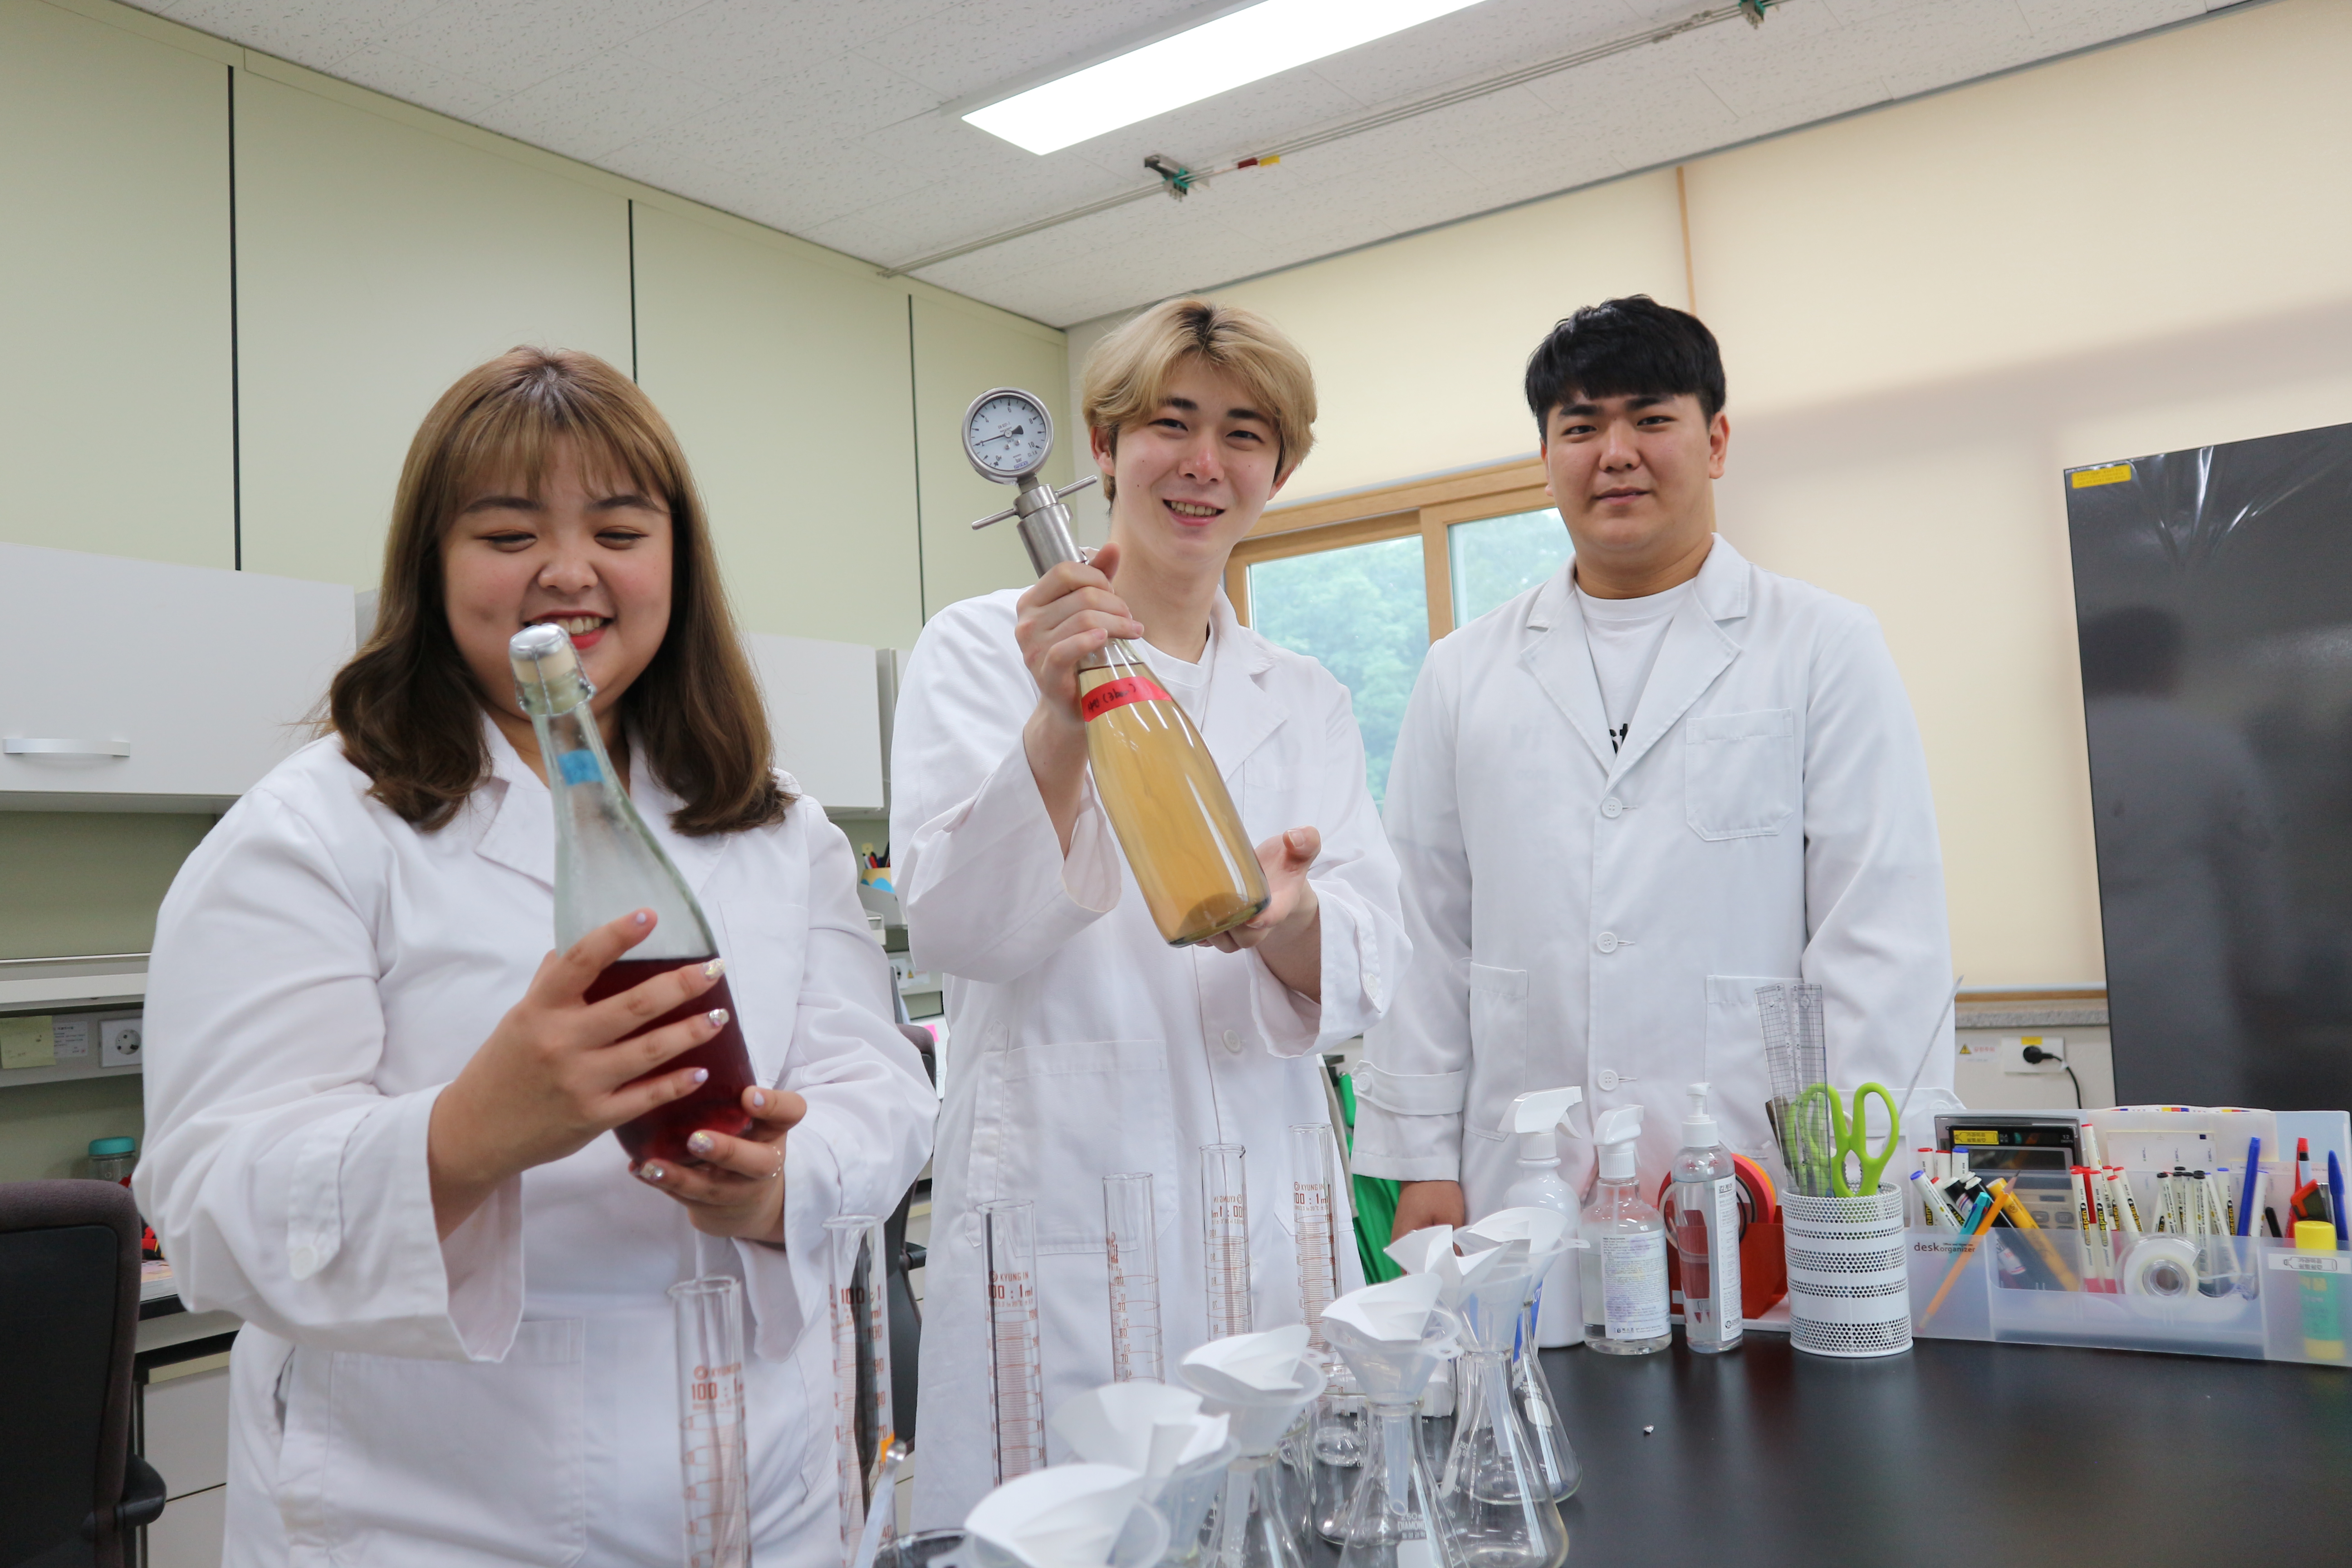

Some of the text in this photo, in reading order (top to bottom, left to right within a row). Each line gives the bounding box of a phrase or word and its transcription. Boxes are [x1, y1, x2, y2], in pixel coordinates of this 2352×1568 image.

[1294, 1192, 1305, 1204] 100
[1000, 1271, 1029, 1282] KYUNG IN
[841, 1287, 865, 1304] 100
[691, 1382, 718, 1401] 100
